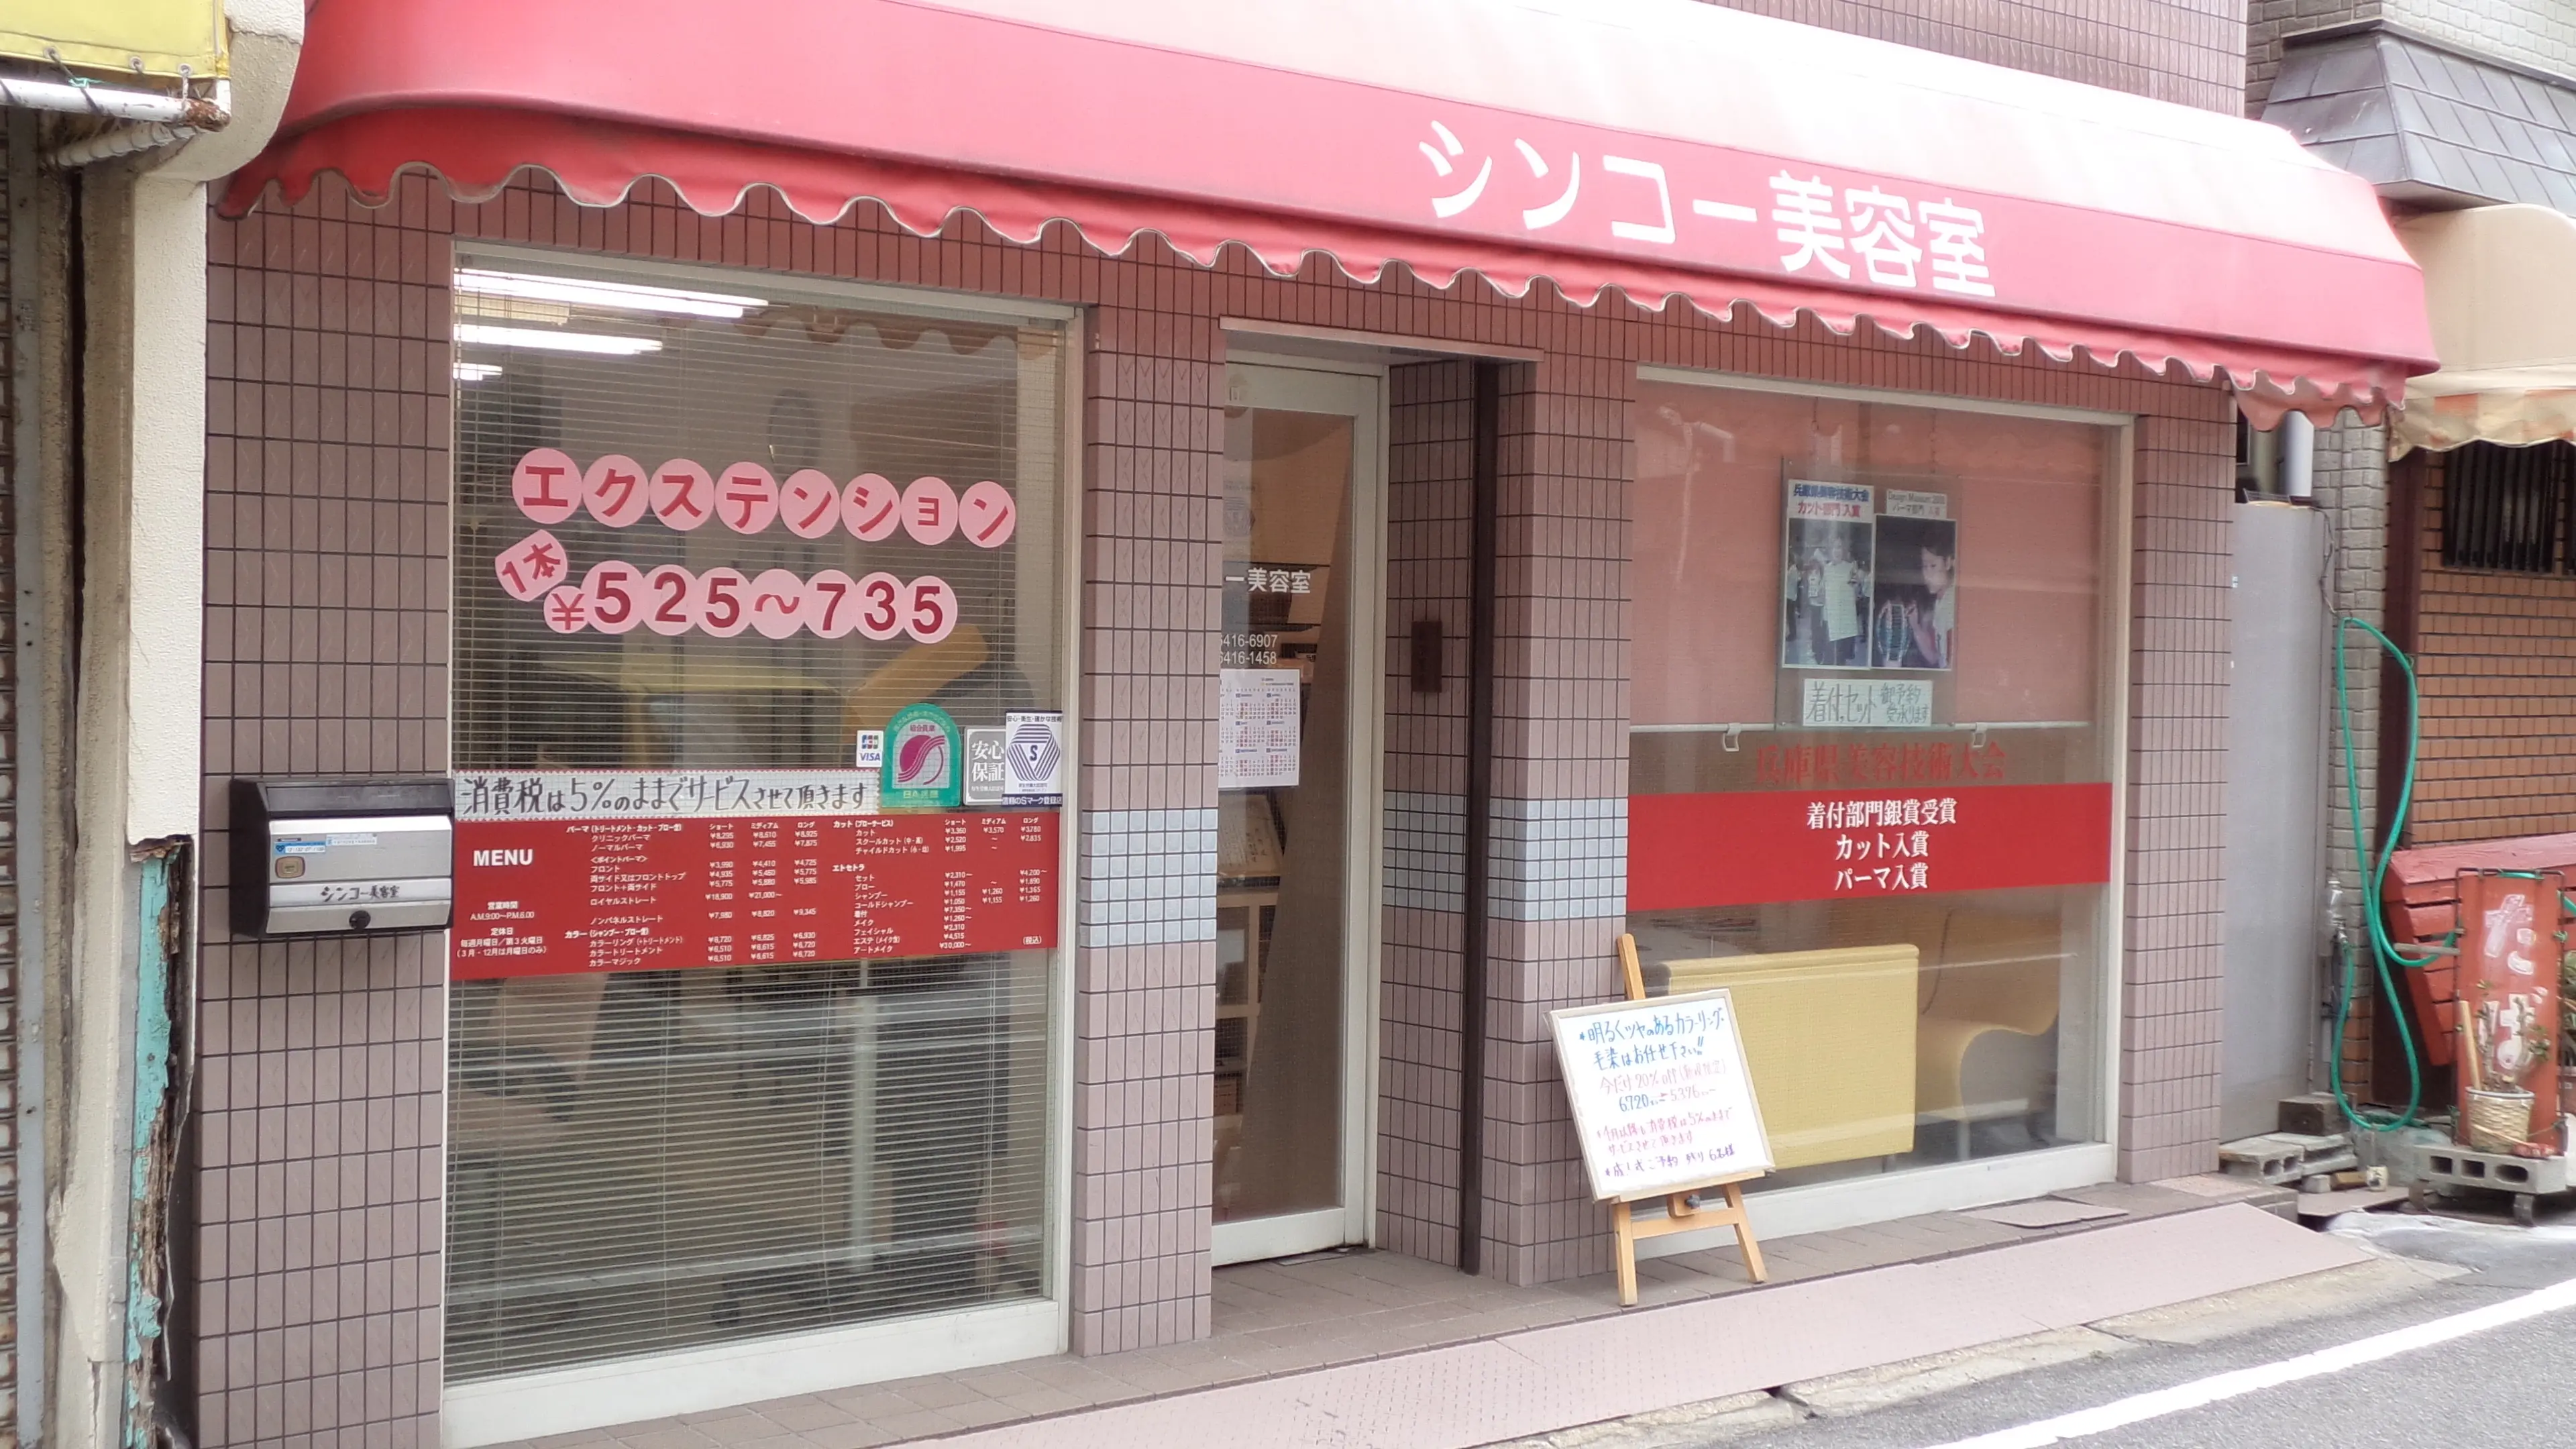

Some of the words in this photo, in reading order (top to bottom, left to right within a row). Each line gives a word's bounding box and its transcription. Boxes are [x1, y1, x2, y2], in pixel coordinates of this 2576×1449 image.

[1419, 120, 1996, 297] シンコー美容室
[523, 466, 1009, 542] エクステンション
[502, 543, 561, 593] 1本
[859, 753, 880, 761] VISA
[971, 740, 1005, 760] 安心
[972, 762, 1005, 782] 保証
[1756, 742, 2007, 786] 兵庫県美容技術大会
[1807, 798, 1957, 830] 着付部門銀賞受賞
[856, 829, 875, 837] カット
[1835, 831, 1929, 859] カット入賞
[474, 849, 533, 867] MENU
[592, 865, 620, 873] フロント
[833, 863, 865, 872] エトセトラ
[855, 874, 874, 882] セット
[1835, 862, 1929, 891] パーマ入賞
[321, 885, 400, 902] シンコー美容室
[591, 896, 656, 906] ロイヤルストレート
[491, 927, 513, 936] 定休日
[854, 928, 894, 936] フェイシャル
[854, 945, 892, 954] アートメイク
[589, 957, 641, 967] カラーマジック
